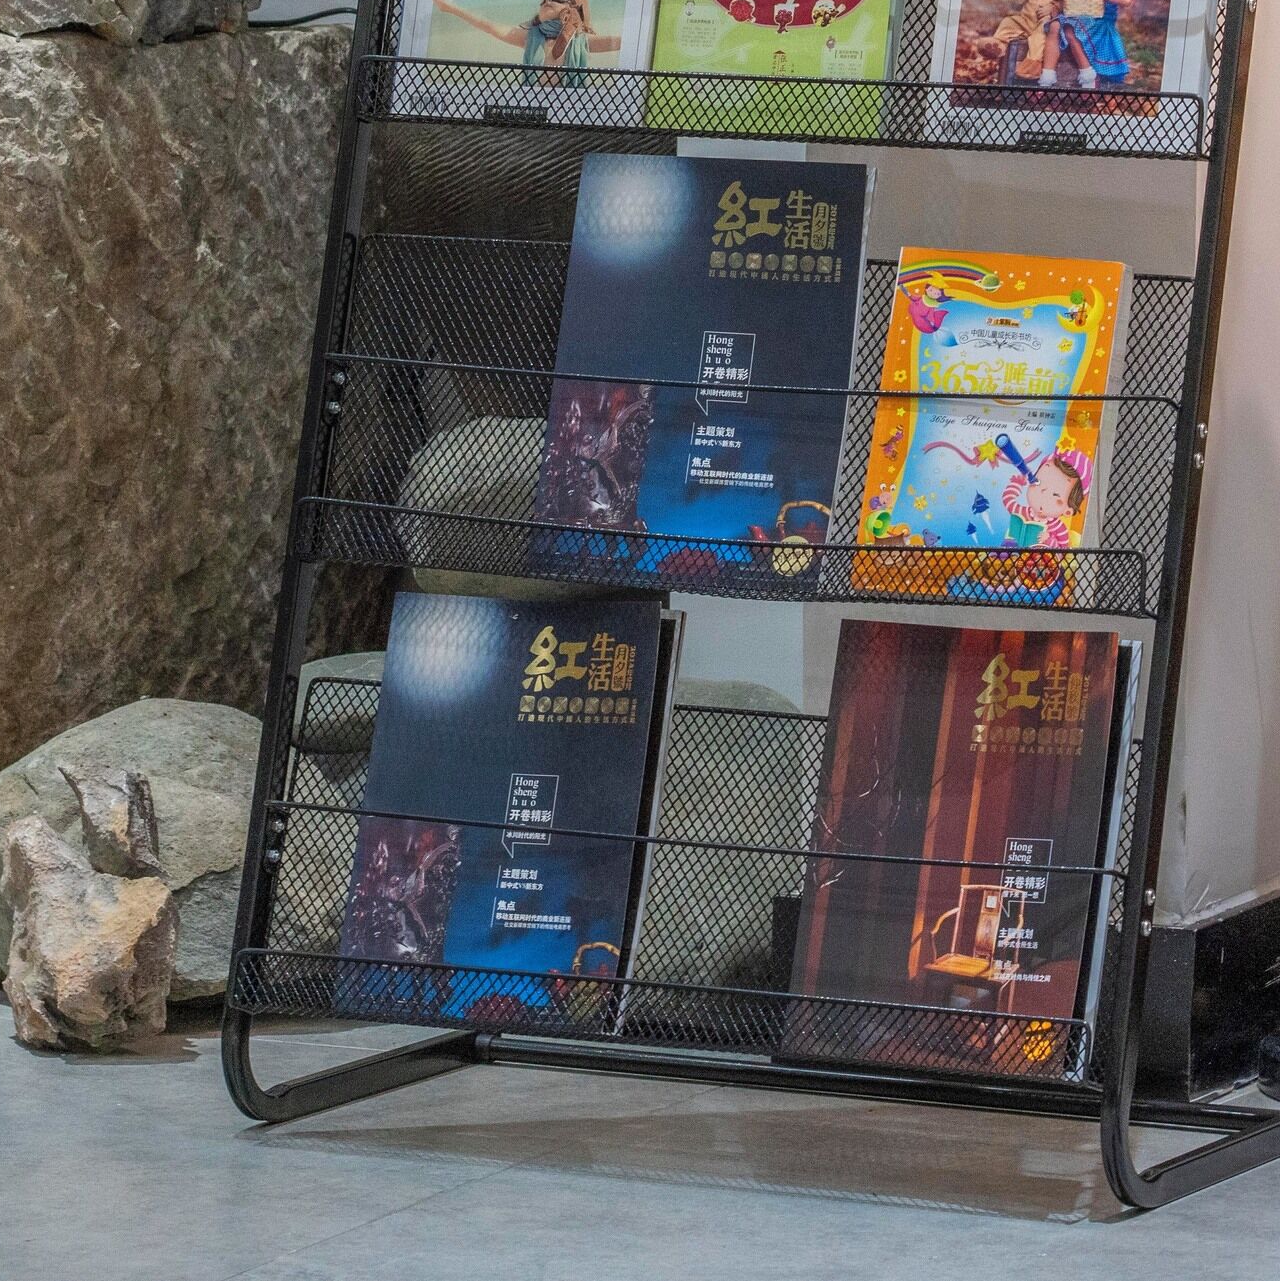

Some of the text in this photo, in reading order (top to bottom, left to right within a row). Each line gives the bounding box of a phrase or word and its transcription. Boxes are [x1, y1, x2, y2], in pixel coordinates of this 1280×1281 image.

[708, 334, 734, 347] Hong
[970, 329, 1032, 341] 中国儿童成长彩书坊
[706, 344, 733, 357] sheng
[702, 366, 749, 381] 开卷精彩
[931, 414, 1047, 432] 365ye Shuiqian Gushi
[696, 425, 735, 438] 主题策划
[691, 456, 712, 468] 焦点
[515, 776, 540, 789] Hong
[513, 786, 538, 799] sheng
[509, 808, 552, 823] 开卷精彩
[1009, 841, 1033, 854] Hong
[1008, 851, 1032, 864] sheng
[502, 868, 538, 881] 主题策划
[1004, 876, 1046, 890] 开卷精彩
[496, 899, 516, 911] 焦点
